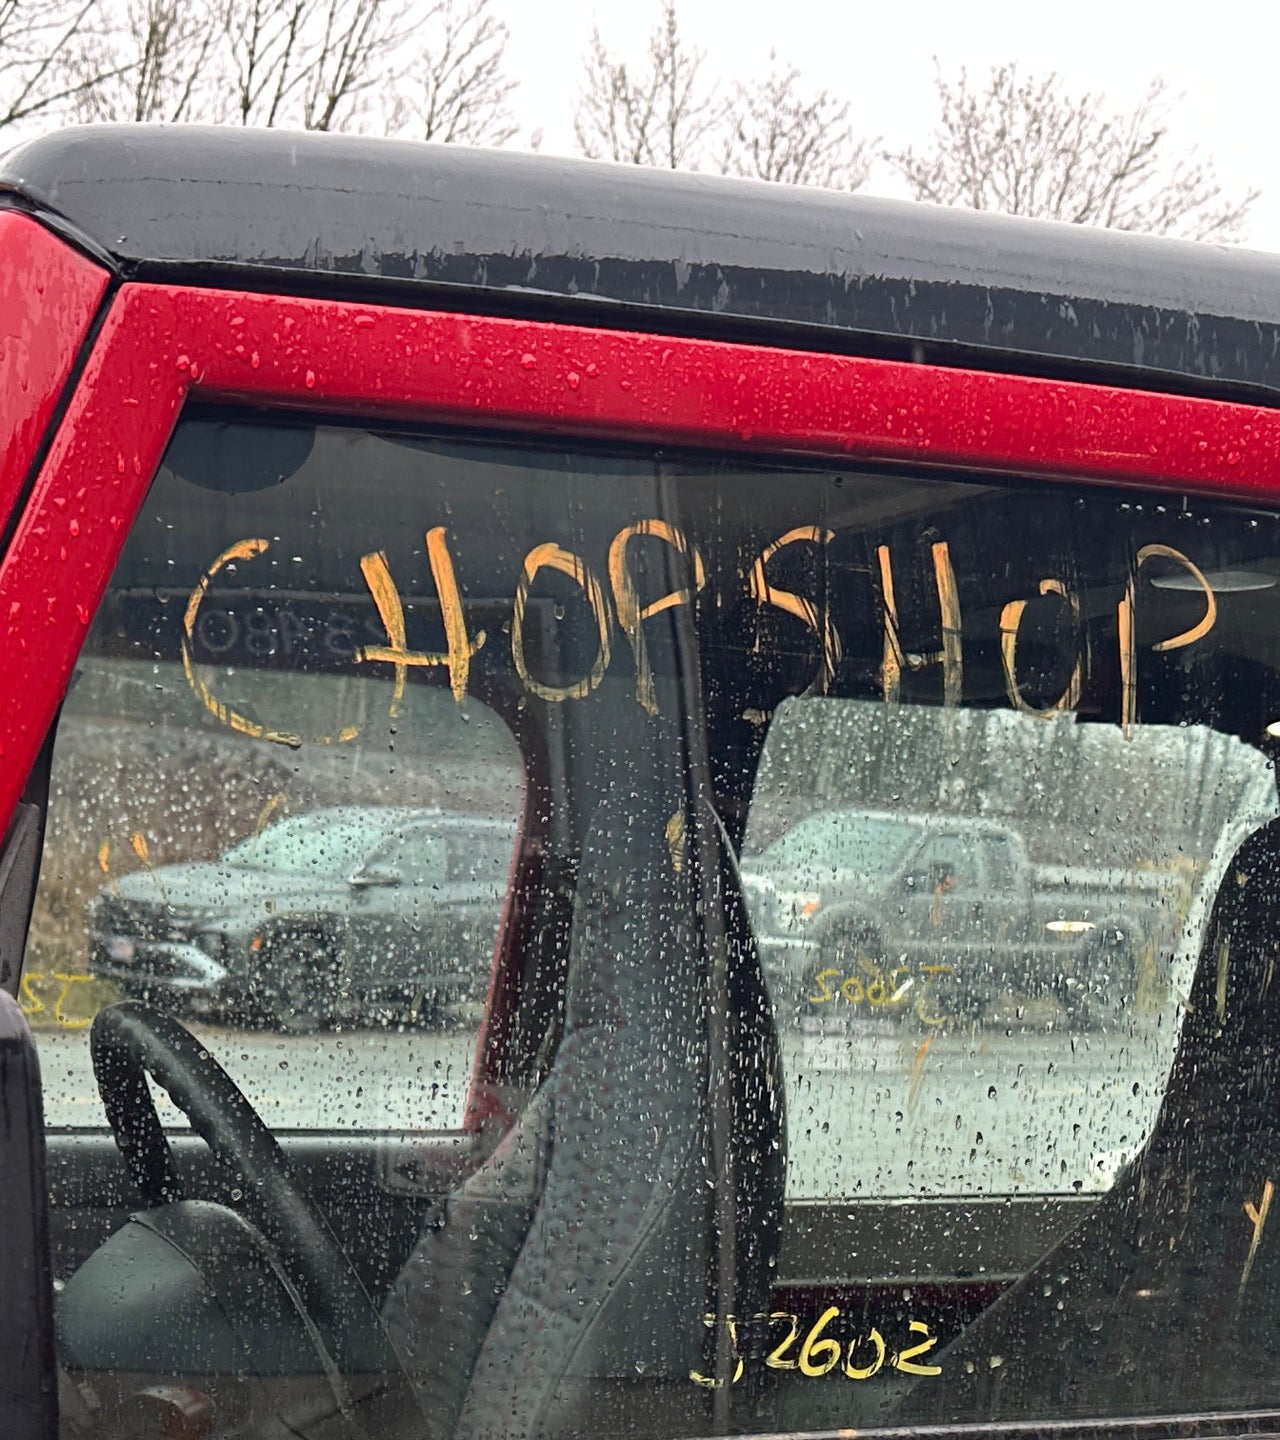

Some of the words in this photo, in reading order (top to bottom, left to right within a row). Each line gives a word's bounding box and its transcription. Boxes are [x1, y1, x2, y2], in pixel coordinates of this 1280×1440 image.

[183, 518, 706, 749] CHOP
[749, 525, 1217, 743] SHOP
[689, 1306, 943, 1389] J2602
